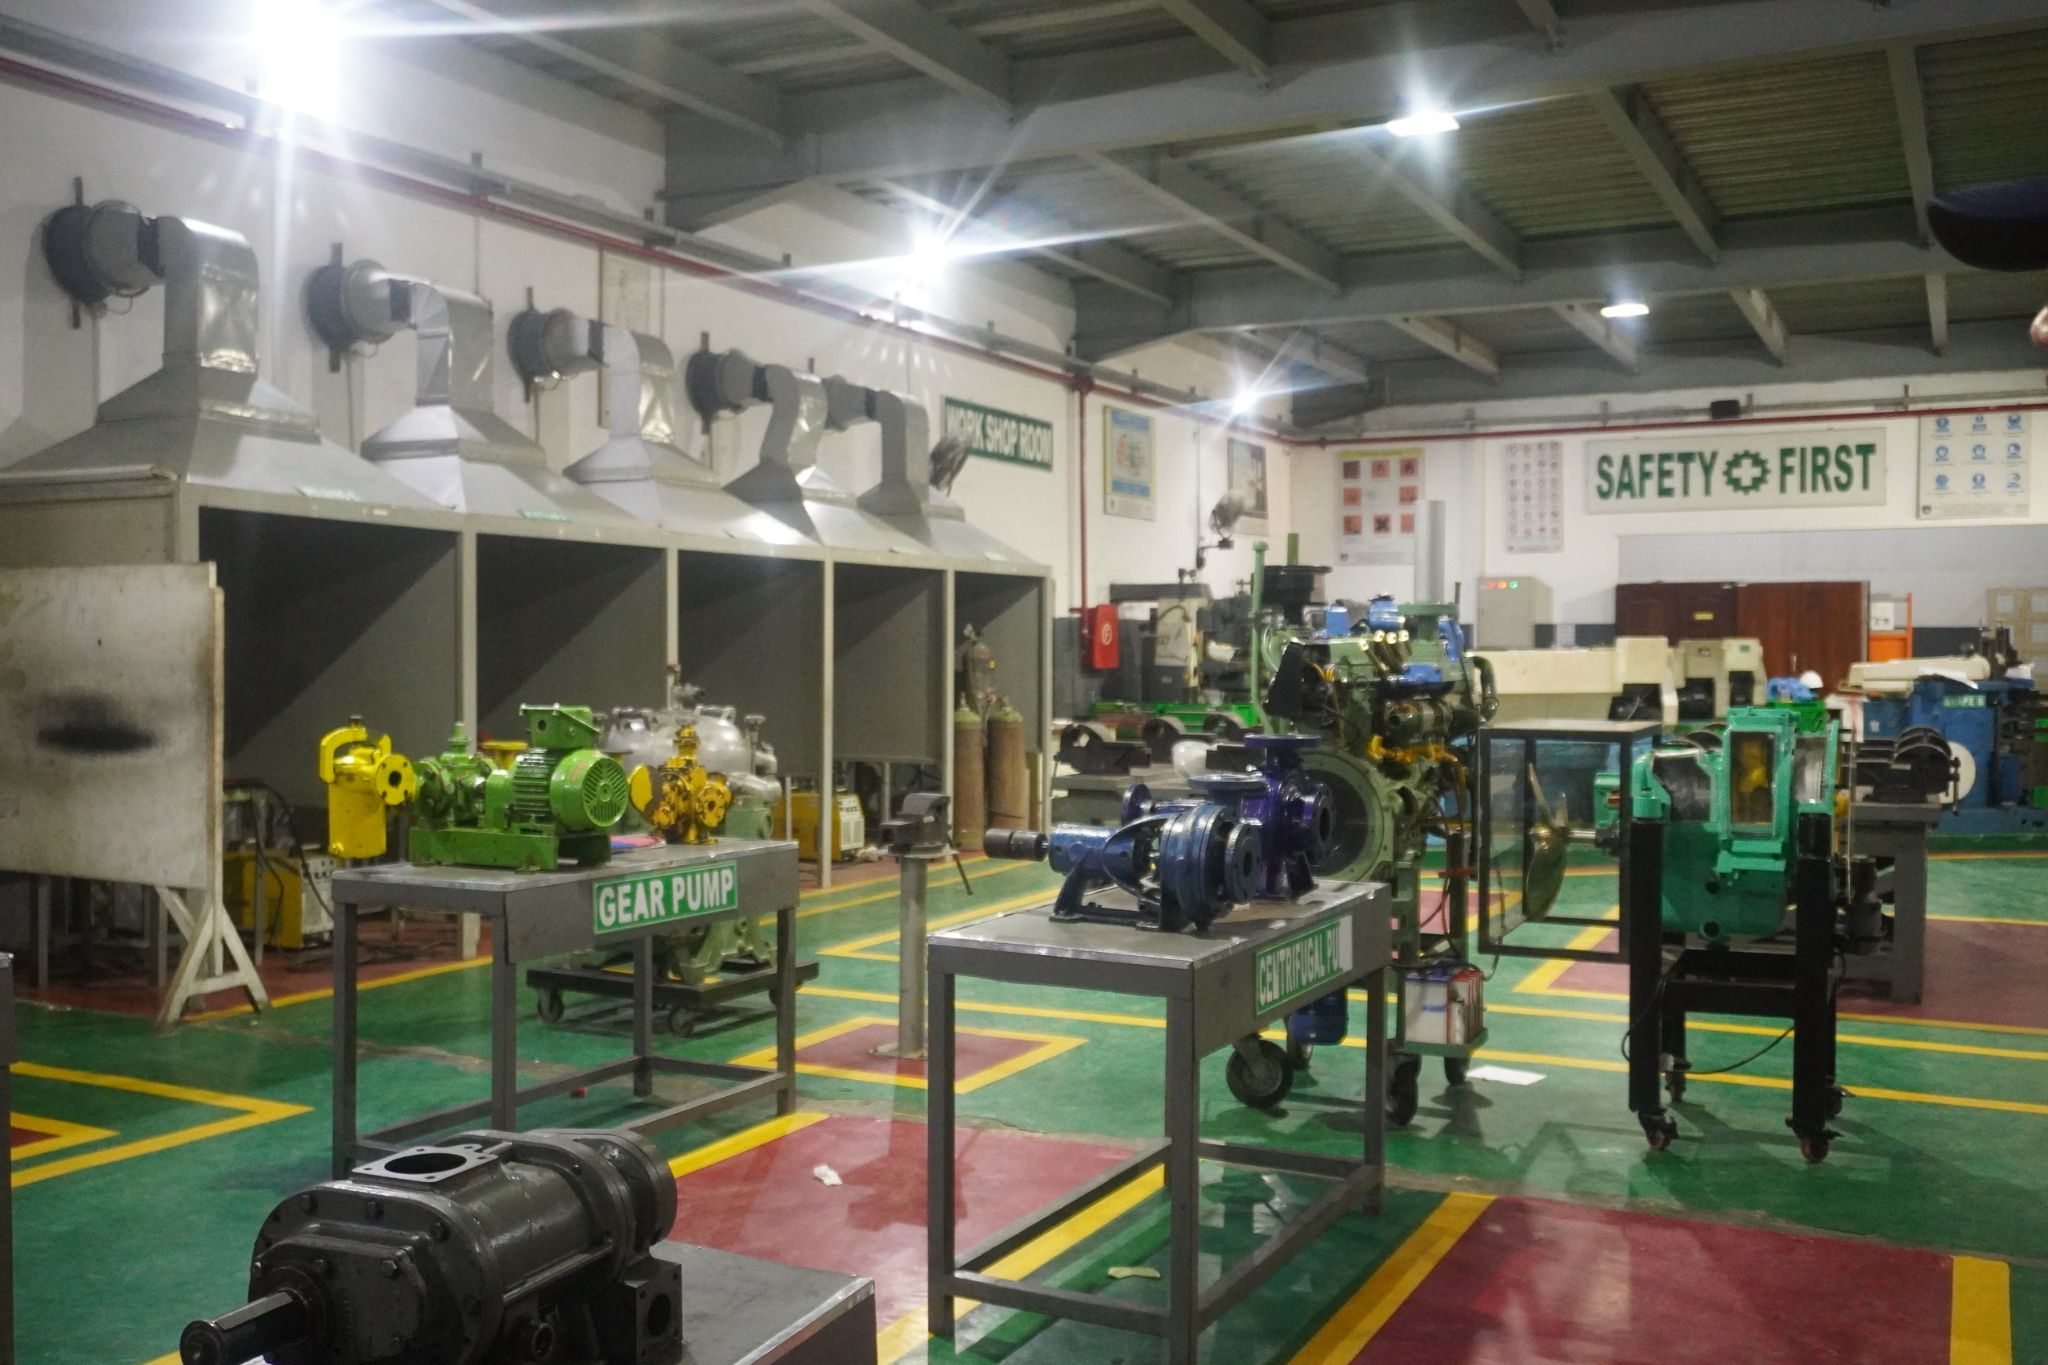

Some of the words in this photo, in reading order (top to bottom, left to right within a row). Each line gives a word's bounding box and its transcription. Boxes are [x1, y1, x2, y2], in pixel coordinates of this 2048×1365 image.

[985, 413, 1017, 456] SHOP
[1019, 421, 1051, 465] ROOM
[1597, 450, 1719, 500] SAFETY
[1780, 443, 1876, 494] FIRST
[600, 879, 665, 927] GEAR
[672, 869, 733, 914] PUMP
[1259, 933, 1325, 1006] CENTRIFUGAL
